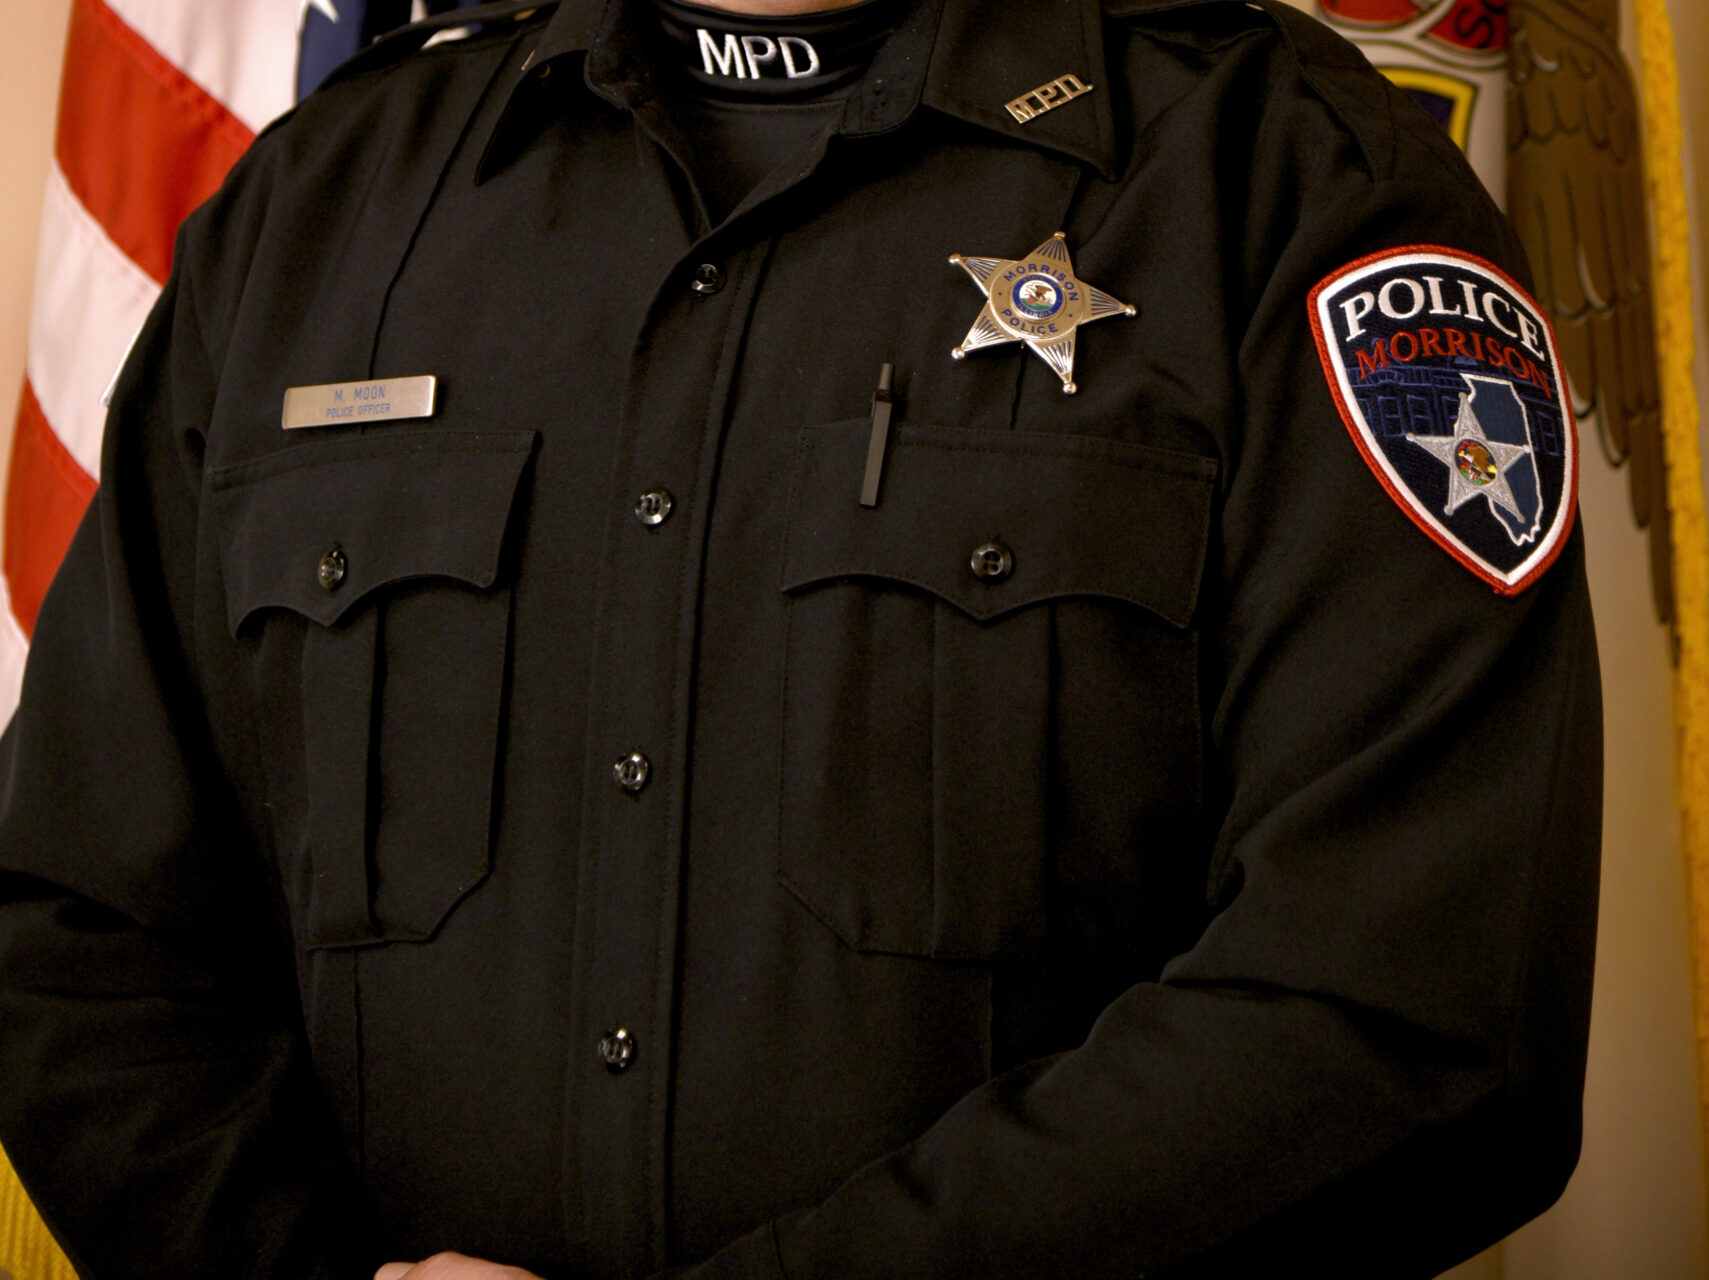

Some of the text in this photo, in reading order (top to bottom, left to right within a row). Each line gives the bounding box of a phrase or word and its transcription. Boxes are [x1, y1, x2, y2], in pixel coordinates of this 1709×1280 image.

[697, 29, 820, 80] MPD
[1005, 73, 1094, 124] MPD
[1003, 263, 1079, 301] MORRISON
[1001, 308, 1059, 335] POLICE
[1339, 275, 1545, 361] POLICE
[1355, 327, 1552, 398] MORRISON
[325, 403, 391, 418] POLICE OFFICER
[353, 385, 387, 401] MOON
